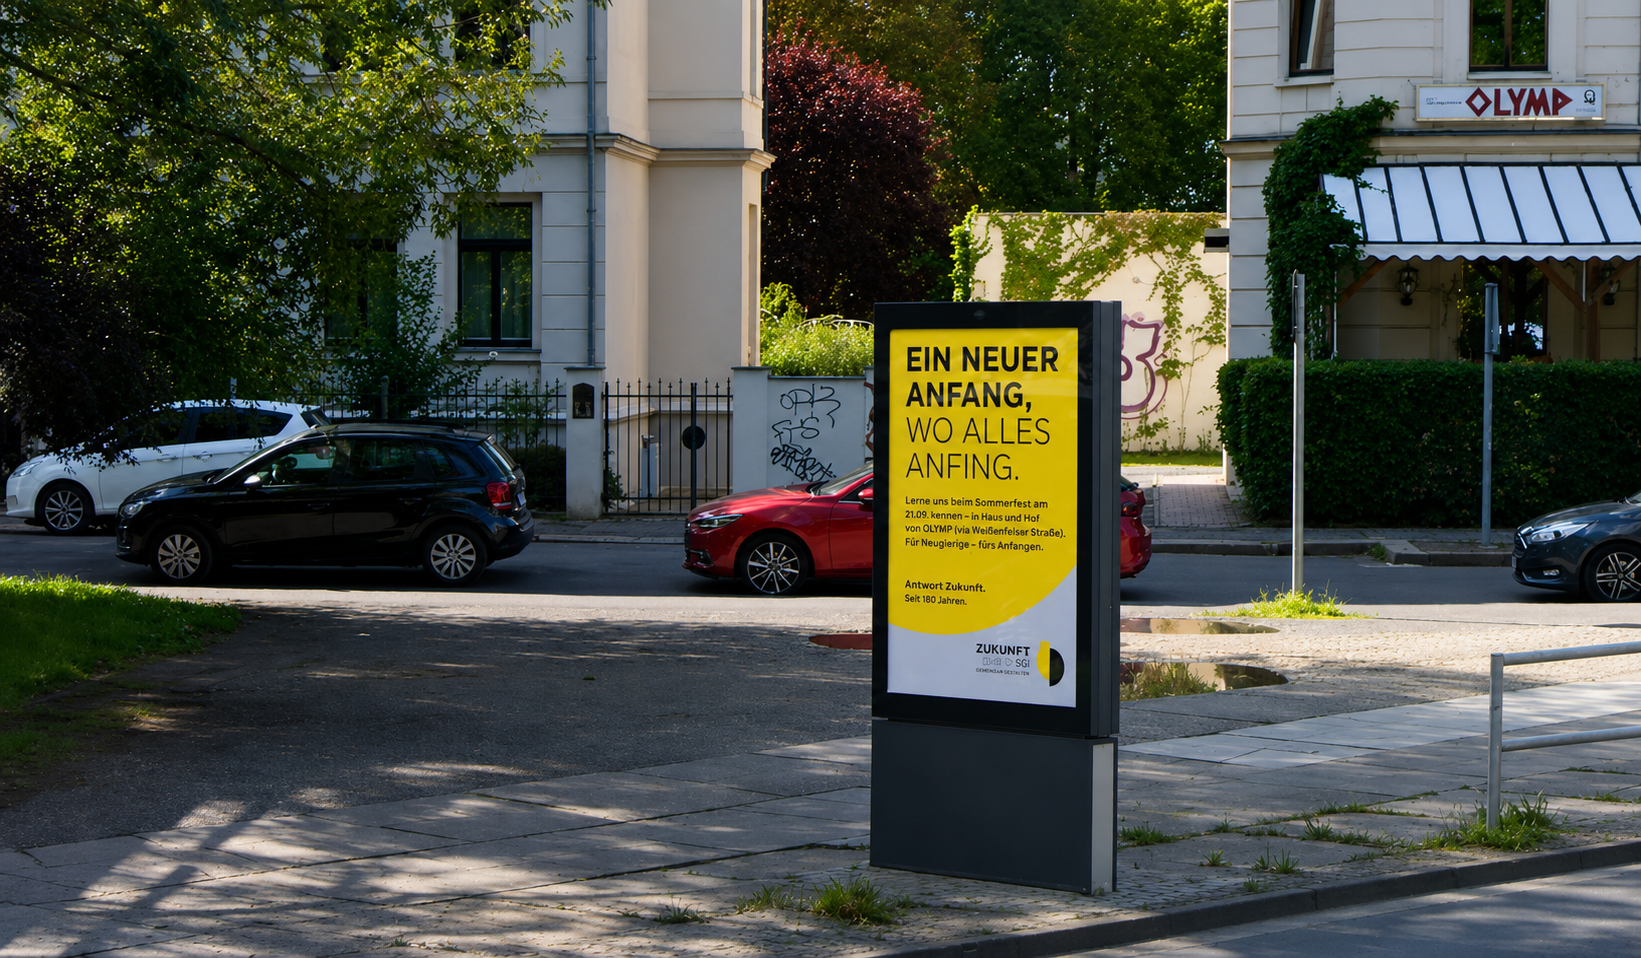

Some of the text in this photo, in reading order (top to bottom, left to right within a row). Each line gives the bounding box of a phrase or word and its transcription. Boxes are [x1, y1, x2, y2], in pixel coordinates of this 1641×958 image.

[1465, 87, 1573, 117] OLYMP
[907, 346, 1058, 372] EIN NEUER
[906, 382, 1032, 413] ANFANG,
[906, 417, 1051, 445] WO ALLES
[906, 453, 1019, 481] ANFING.
[905, 496, 1048, 509] Lerne uns beim Sommerfest am
[905, 511, 930, 519] 21.09.
[931, 511, 963, 520] kennen
[971, 512, 979, 521] in
[981, 513, 1003, 522] Haus
[1005, 513, 1022, 522] und
[1024, 514, 1040, 523] Hof
[905, 524, 1066, 539] von OLYMP (via Weißenfelser Straße).
[905, 538, 920, 547] Für
[921, 538, 970, 550] Neugierige
[978, 540, 996, 549] fürs
[998, 541, 1044, 552] Anfangen.
[905, 580, 986, 592] Antwort Zukunft.
[905, 594, 967, 605] Seit 180 Jahren.
[976, 643, 1030, 656] ZUKUNFT
